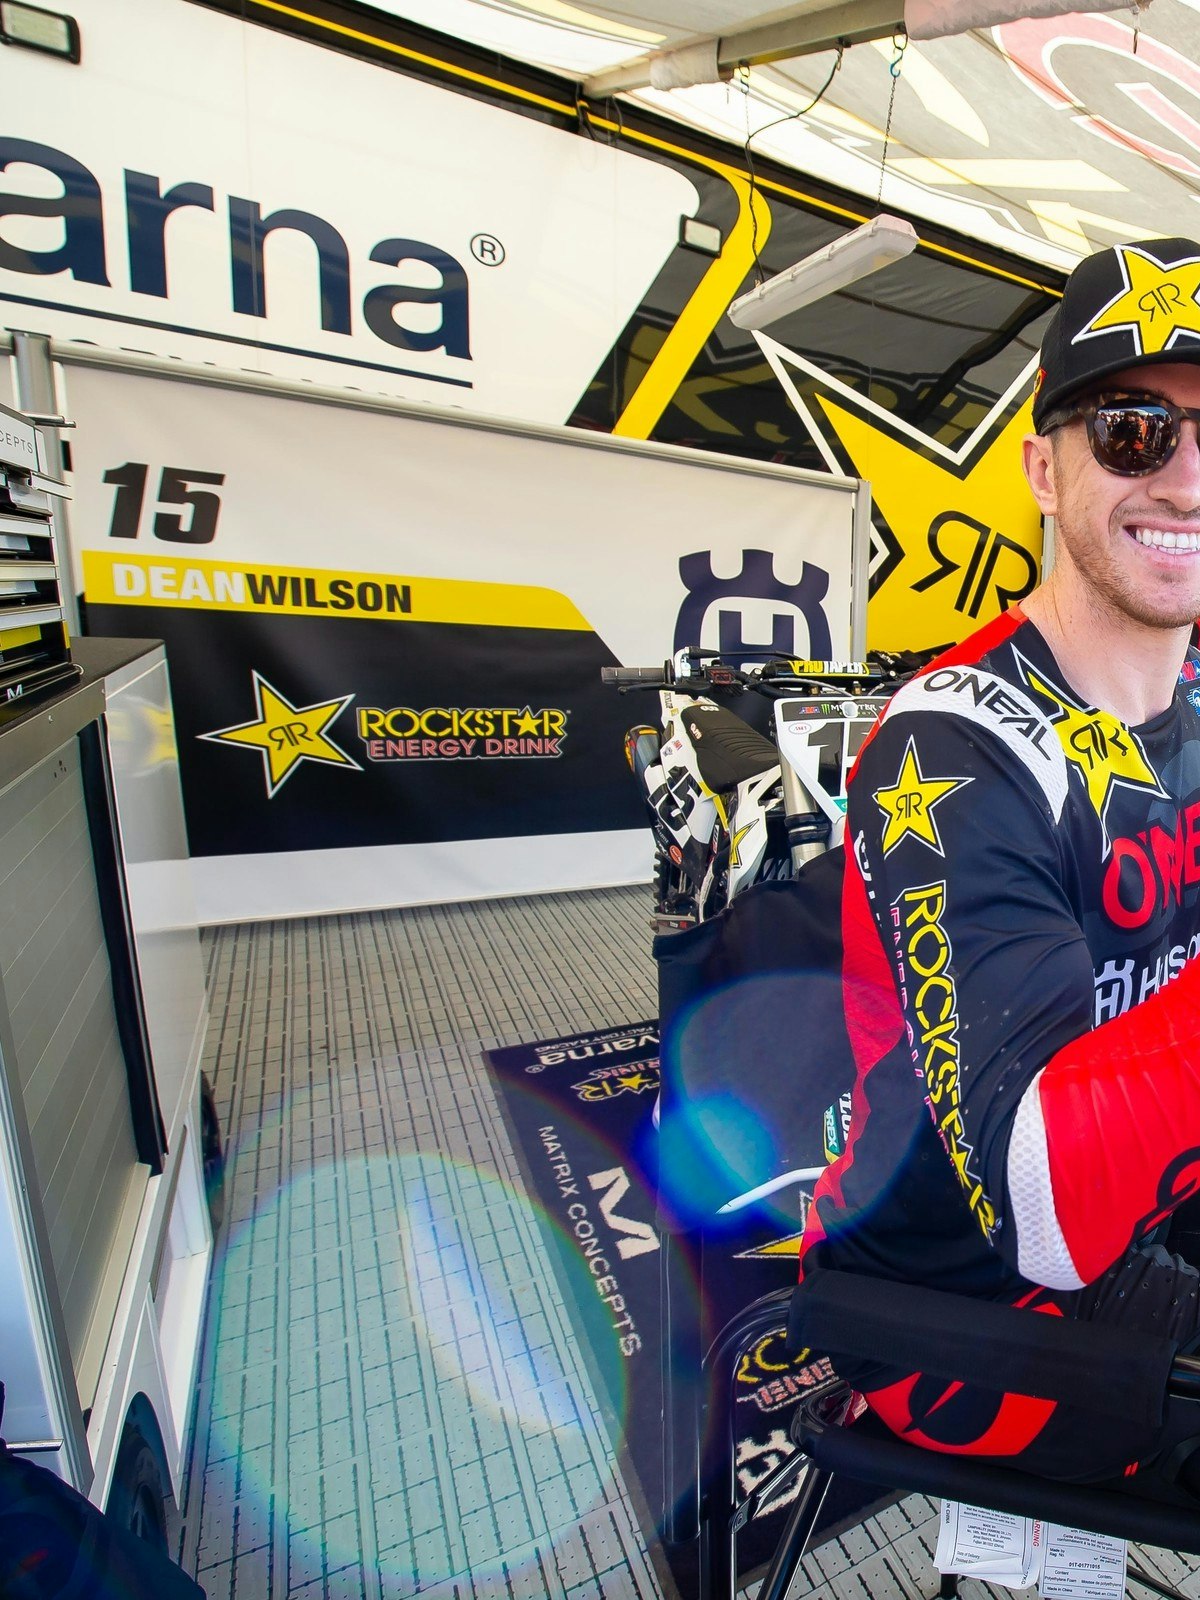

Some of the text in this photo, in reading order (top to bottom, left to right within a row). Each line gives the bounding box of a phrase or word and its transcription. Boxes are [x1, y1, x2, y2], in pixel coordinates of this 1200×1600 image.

[102, 462, 226, 545] 15
[369, 737, 560, 757] ENERGY DRINK
[538, 1125, 643, 1357] MATRIX CONCEPTS
[587, 1166, 661, 1260] M
